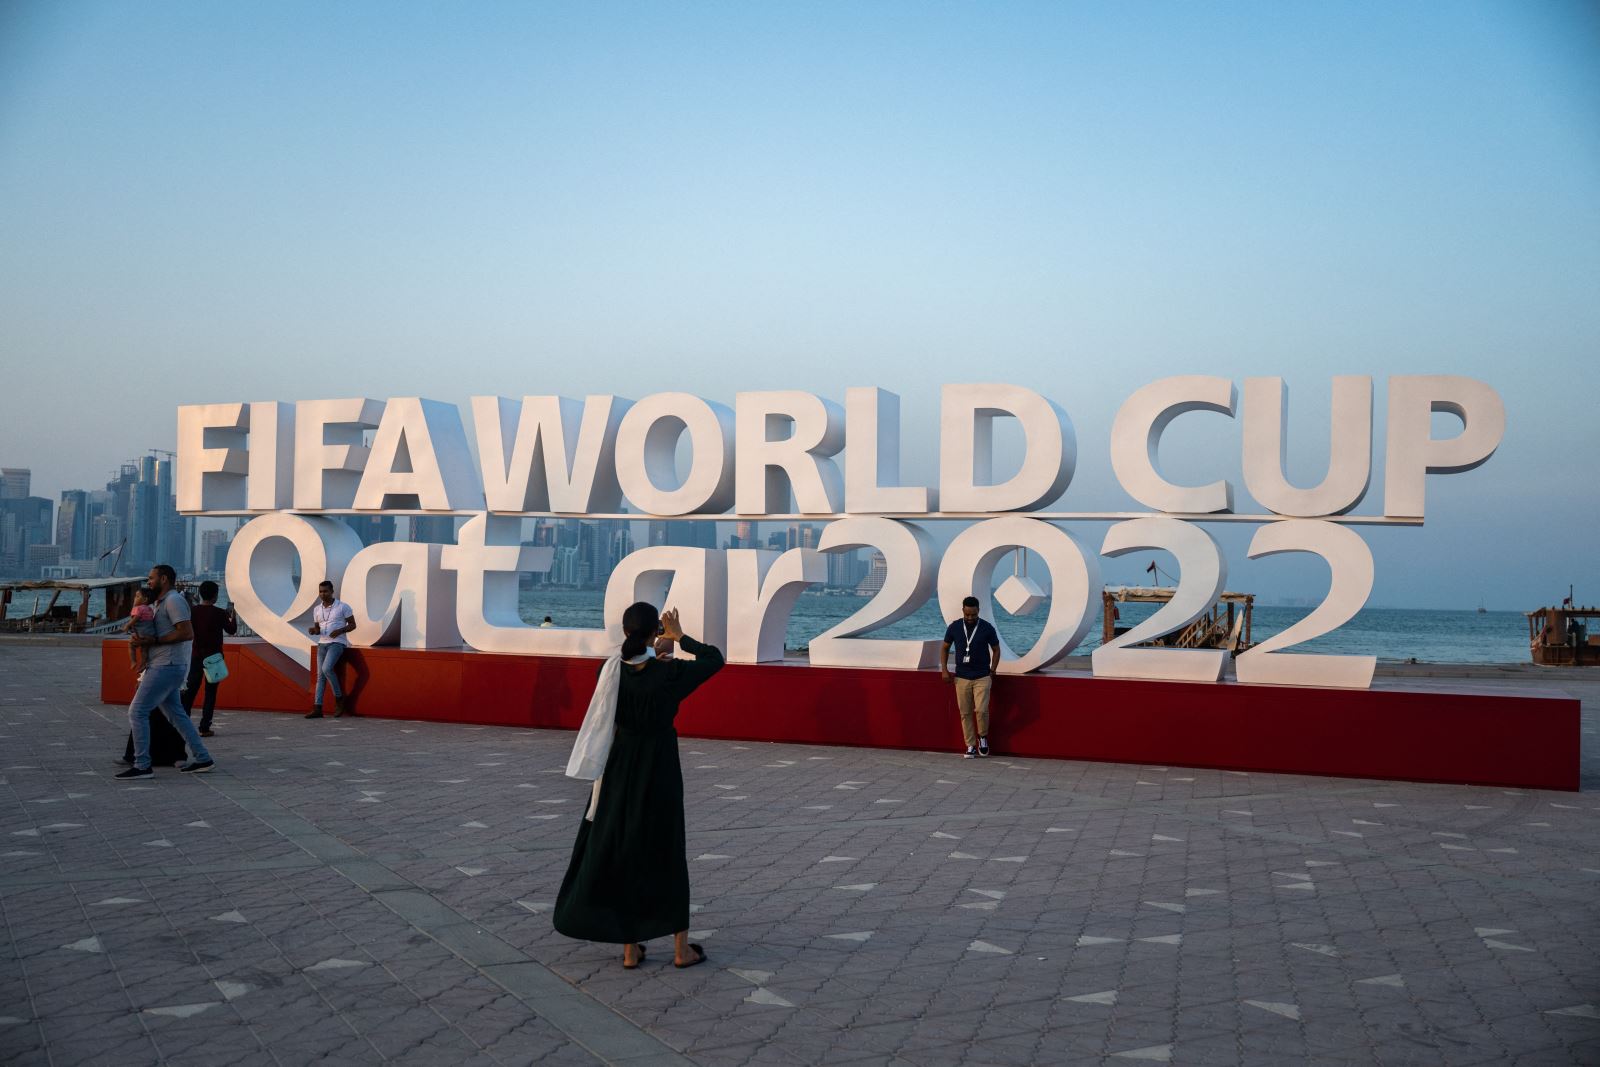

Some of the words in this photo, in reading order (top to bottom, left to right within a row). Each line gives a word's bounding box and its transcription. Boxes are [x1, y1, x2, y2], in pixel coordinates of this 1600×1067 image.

[176, 397, 453, 512] FIFA
[470, 383, 1066, 516] WORLD
[1110, 375, 1506, 518] CUP
[225, 512, 806, 671] Qatar
[808, 516, 1377, 690] 2022
